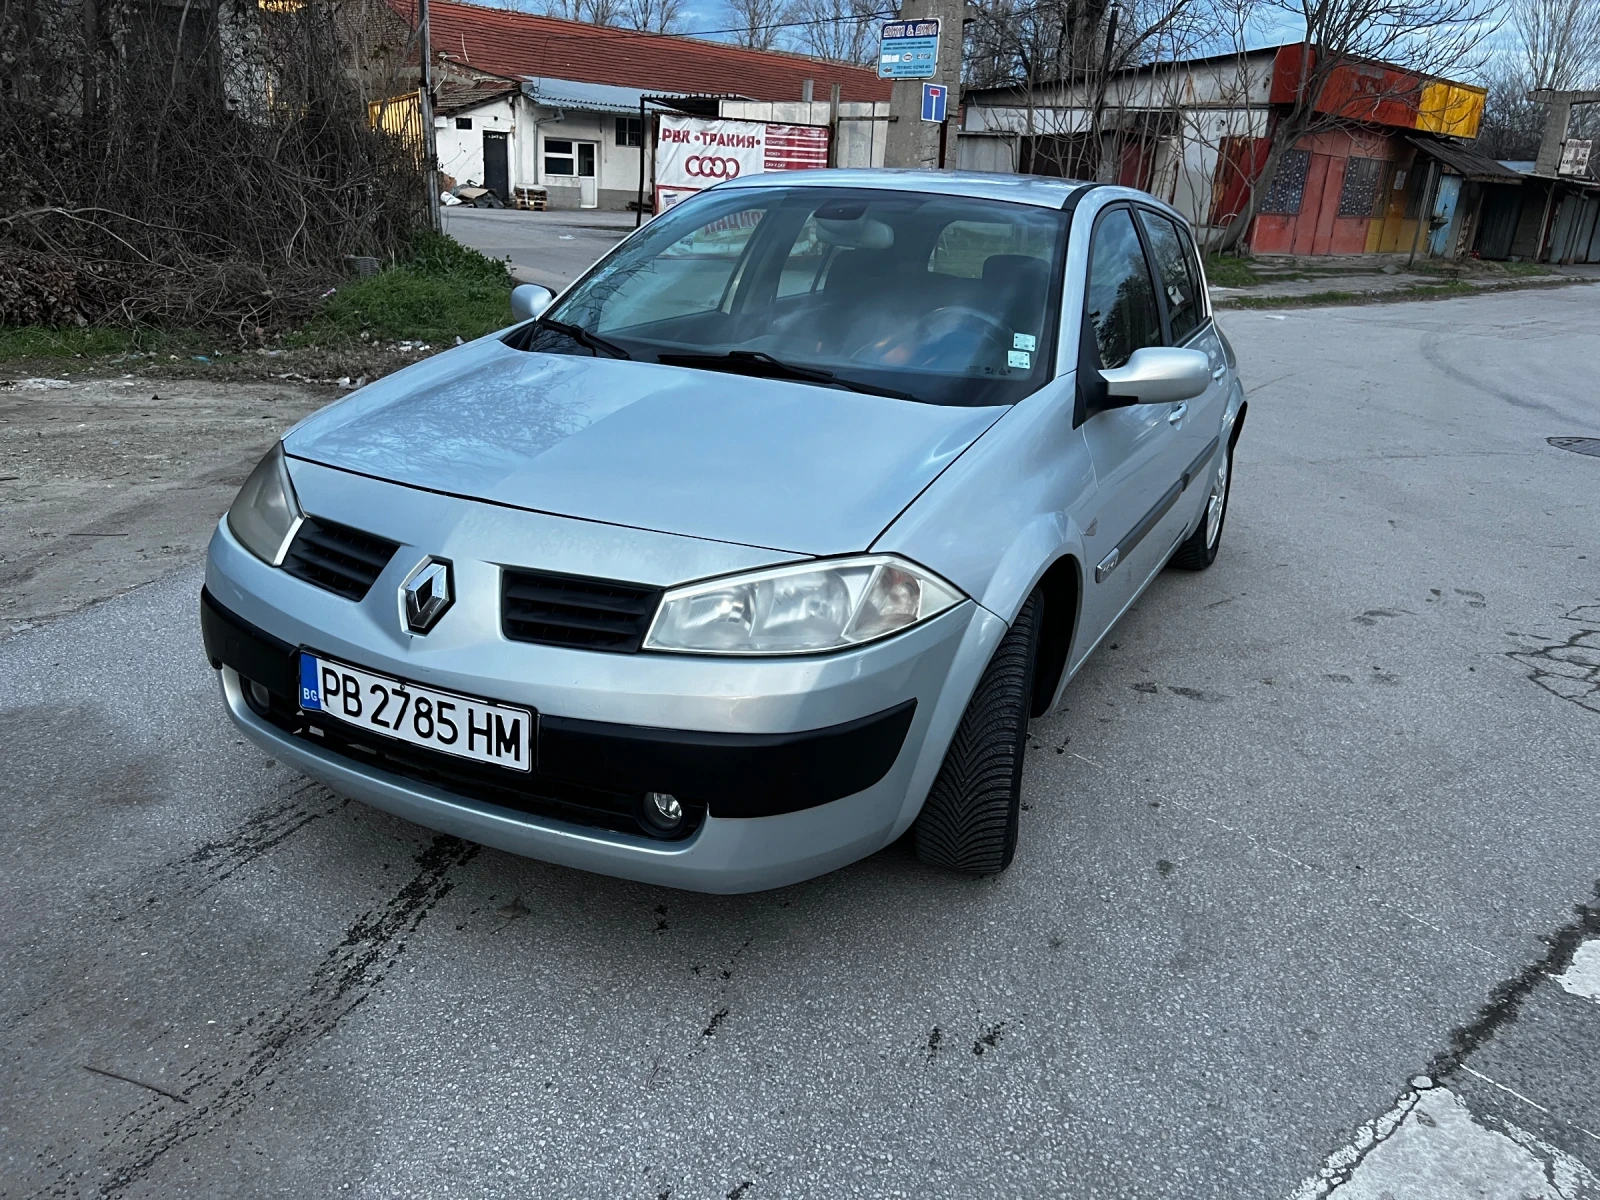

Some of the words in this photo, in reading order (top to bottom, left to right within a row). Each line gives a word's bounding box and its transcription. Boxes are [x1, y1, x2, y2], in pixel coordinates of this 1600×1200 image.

[906, 24, 915, 37] &
[661, 128, 691, 144] РВК
[303, 687, 318, 702] BG
[321, 666, 363, 718] PB
[369, 683, 459, 746] 2785
[467, 707, 521, 763] HM
